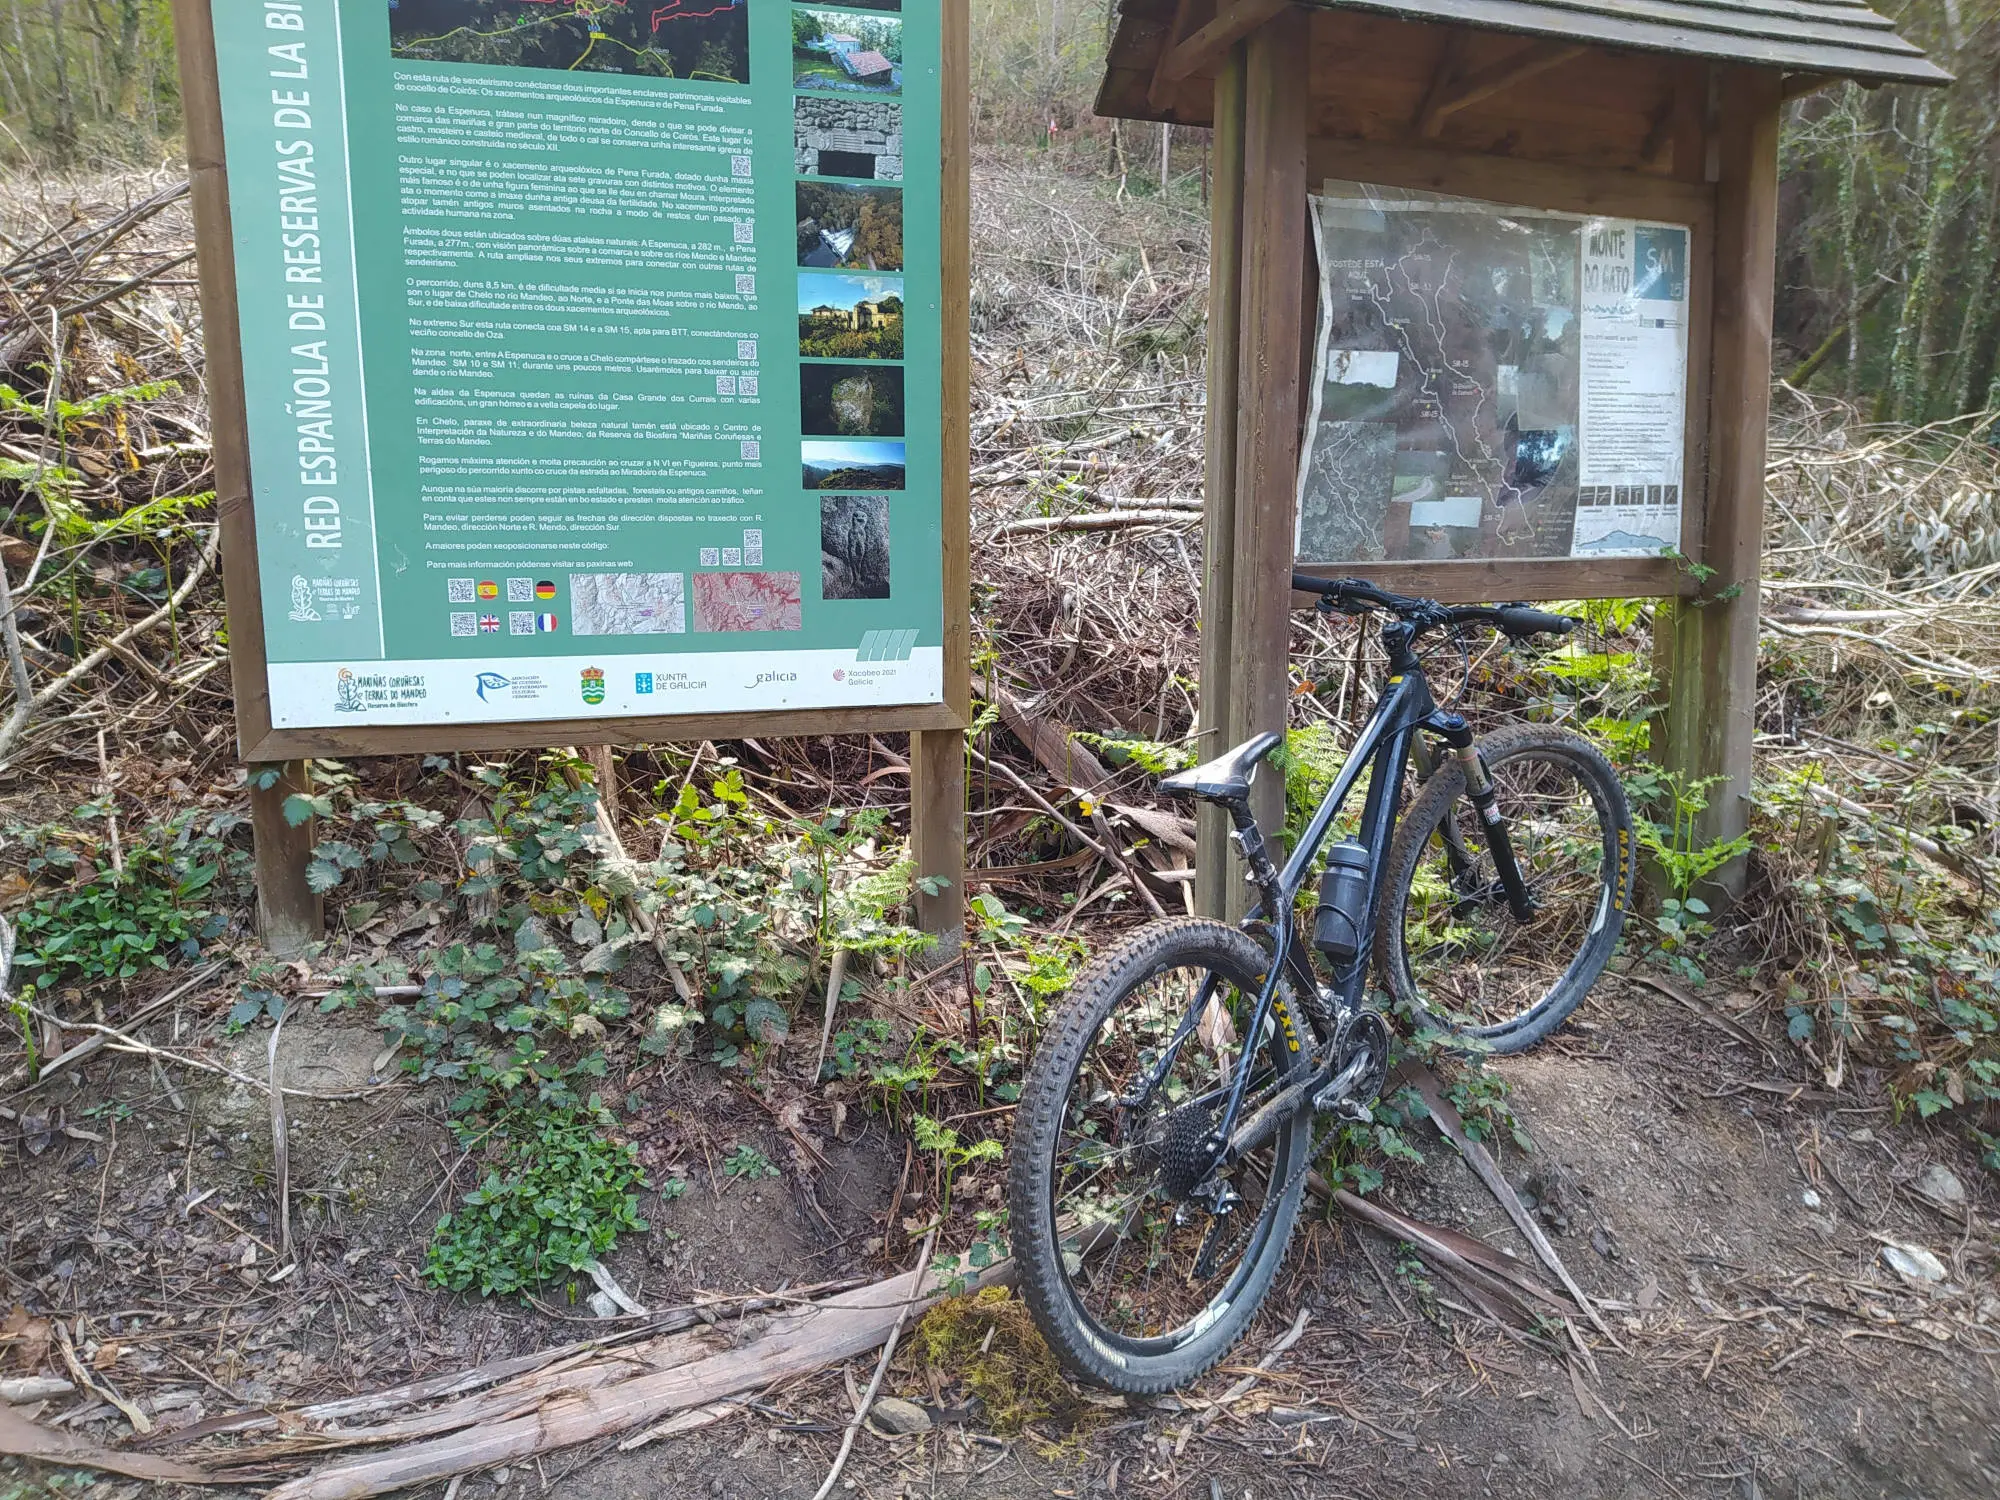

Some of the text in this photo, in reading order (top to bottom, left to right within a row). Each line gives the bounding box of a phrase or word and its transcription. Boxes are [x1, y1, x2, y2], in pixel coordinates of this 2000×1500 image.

[268, 42, 308, 80] LA
[393, 70, 412, 80] Con
[412, 72, 432, 81] esta
[432, 73, 450, 83] ruta
[450, 75, 462, 84] de
[562, 83, 583, 92] dous
[584, 84, 632, 97] importantes
[632, 88, 668, 98] enclaves
[669, 90, 715, 103] patrimonais
[716, 94, 752, 104] visitables
[394, 81, 406, 90] do
[436, 84, 449, 93] de
[481, 87, 494, 96] Os
[494, 88, 545, 100] xacementos
[545, 92, 603, 105] arqueolóxicos
[603, 96, 614, 104] da
[615, 97, 655, 109] Espenuca
[662, 100, 673, 108] de
[673, 101, 695, 110] Pena
[271, 89, 312, 129] DE
[397, 134, 421, 143] estilo
[518, 141, 546, 150] século
[275, 140, 323, 283] RESERVAS
[401, 206, 445, 216] actividade
[445, 208, 480, 217] humana
[441, 228, 462, 236] dous
[463, 229, 487, 238] están
[488, 230, 526, 240] ubicados
[527, 232, 550, 241] sobre
[551, 234, 572, 242] dúas
[697, 242, 712, 250] 282
[736, 244, 756, 252] Pena
[1590, 229, 1626, 258] MONTE
[1645, 246, 1674, 273] SM
[286, 294, 327, 330] DE
[423, 318, 458, 327] extremo
[459, 319, 474, 327] Sur
[475, 320, 494, 328] esta
[495, 321, 512, 329] ruta
[512, 321, 545, 330] conecta
[633, 326, 651, 336] apta
[474, 389, 516, 398] Espenuca
[519, 390, 551, 399] quedan
[284, 340, 338, 485] ESPAÑOLA
[303, 495, 342, 548] RED
[466, 542, 493, 550] poden
[516, 560, 551, 568] pódense
[358, 674, 425, 688] MARIÑAS CORUÑESAS
[656, 672, 688, 682] XUNTA
[656, 680, 707, 690] DE GALICIA
[748, 671, 797, 687] galicia
[365, 690, 388, 701] TERRAS
[390, 691, 398, 700] DO
[401, 688, 427, 699] MANDEO
[1614, 828, 1630, 911] MAXXIS
